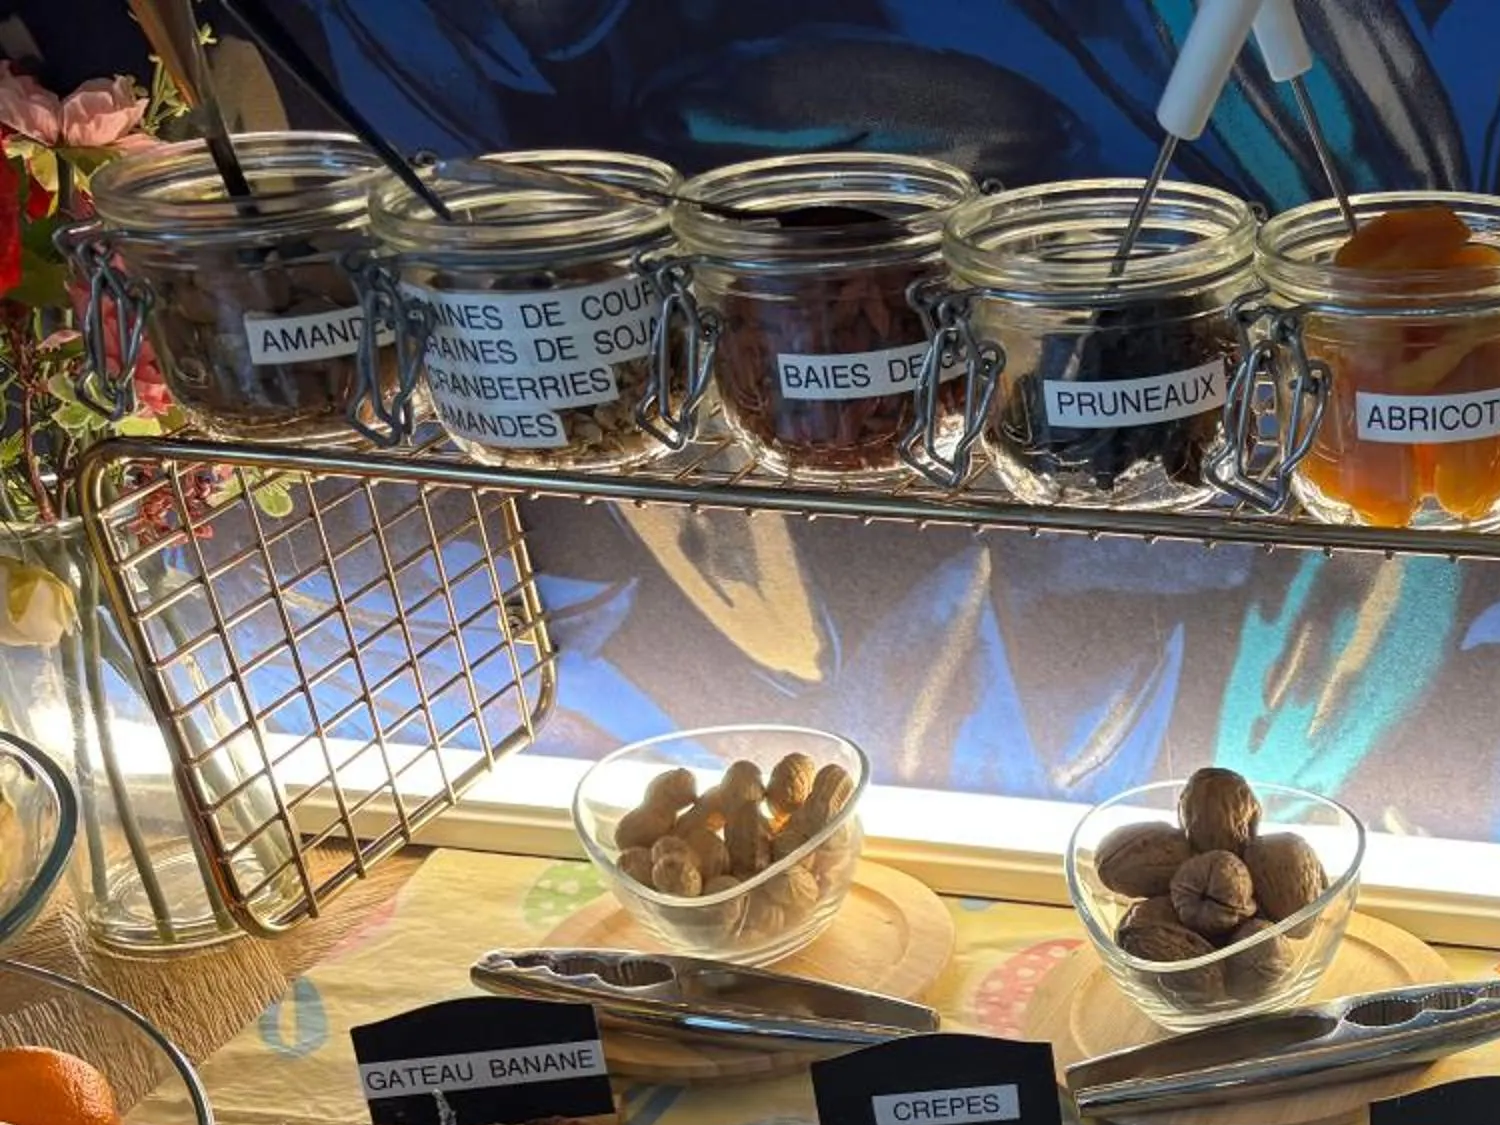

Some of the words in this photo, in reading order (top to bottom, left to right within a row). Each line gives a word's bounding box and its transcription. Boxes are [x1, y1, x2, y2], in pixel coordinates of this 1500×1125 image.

[520, 301, 565, 329] DE
[534, 335, 577, 363] DE
[783, 361, 871, 389] BAIES
[887, 354, 924, 382] DE
[1056, 377, 1217, 419] PRUNEAUX
[441, 403, 558, 438] AMANDES
[366, 1060, 474, 1092] GATEAU
[490, 1048, 597, 1080] BANANE
[893, 1092, 1000, 1121] CREPES
